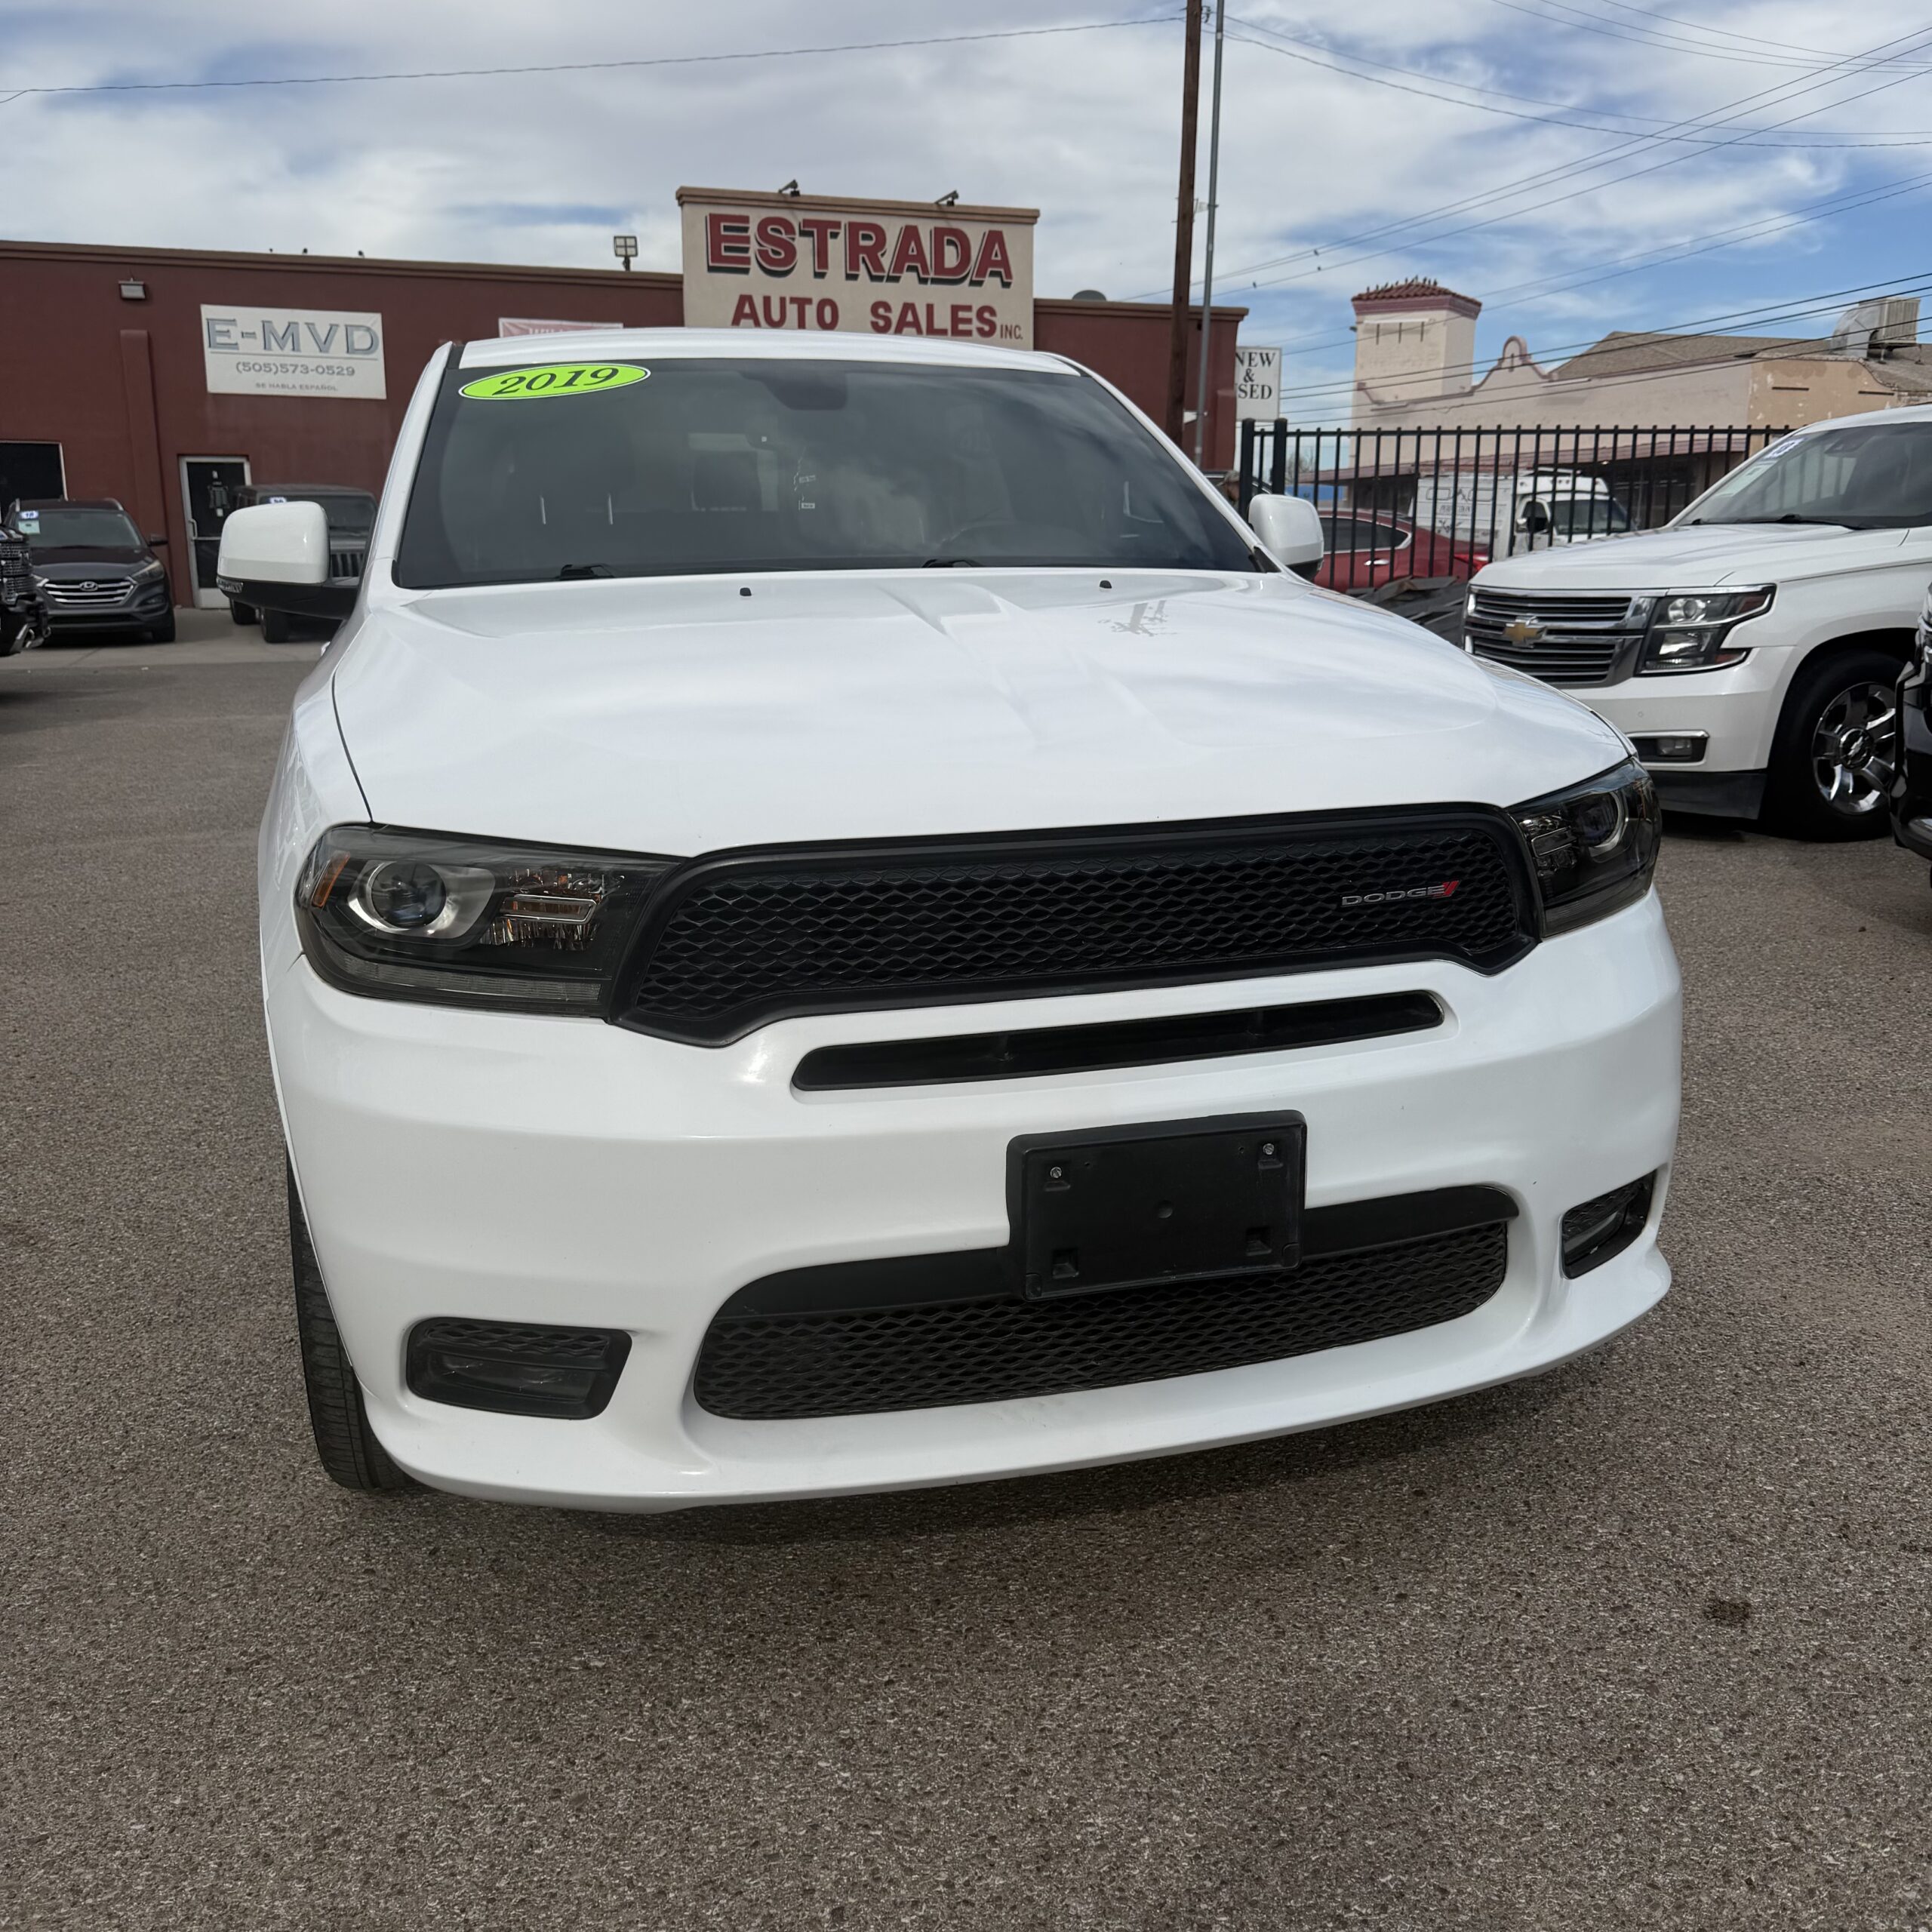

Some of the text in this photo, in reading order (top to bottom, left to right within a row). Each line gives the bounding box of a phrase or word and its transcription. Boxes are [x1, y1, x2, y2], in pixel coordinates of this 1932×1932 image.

[706, 212, 1014, 288] ESTRADA
[731, 294, 1023, 340] AUTO SALES INC.
[206, 317, 380, 355] E-MVD
[235, 361, 355, 377] (505)573-0529
[1235, 352, 1276, 368] NEW
[491, 368, 620, 396] 2019
[1243, 368, 1255, 383] &
[1235, 383, 1272, 399] SED
[1341, 884, 1444, 906] DODGE
